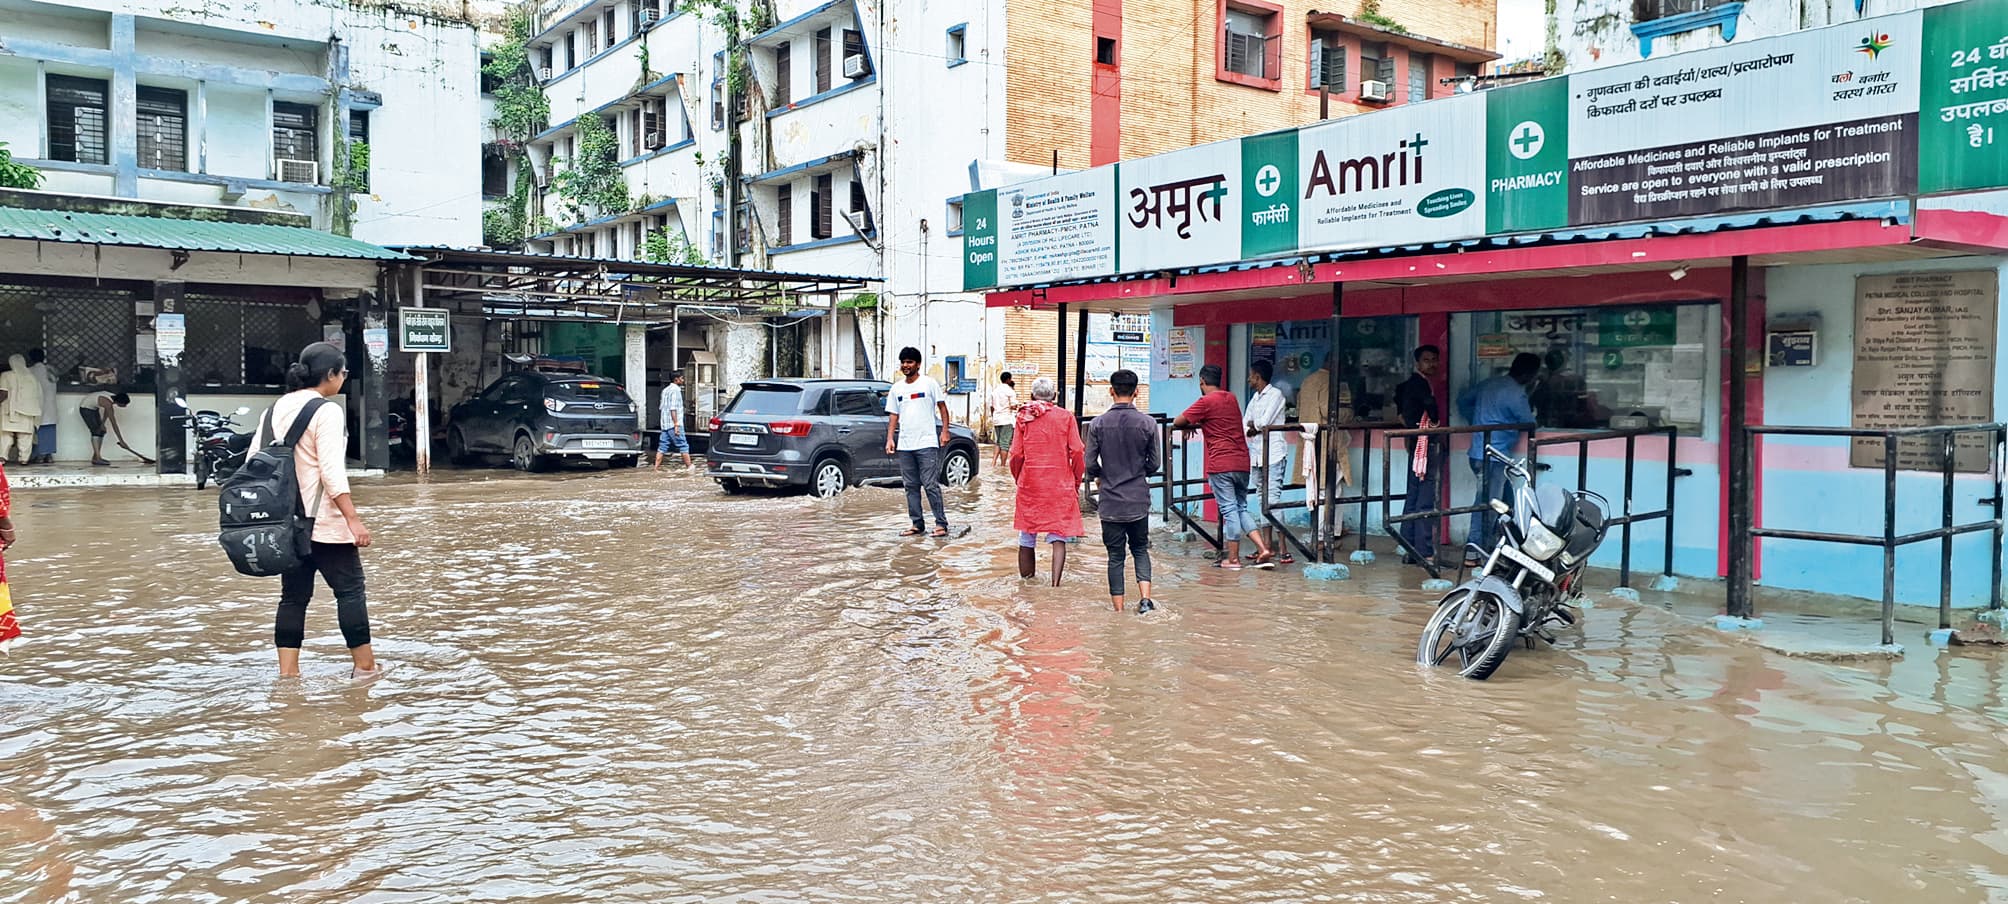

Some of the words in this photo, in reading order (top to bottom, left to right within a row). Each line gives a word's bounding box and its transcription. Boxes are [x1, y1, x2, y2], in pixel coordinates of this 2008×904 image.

[1951, 47, 1982, 68] 24
[1832, 70, 1853, 83] चलो
[1587, 82, 1631, 103] गुणवत्ता
[1634, 75, 1650, 90] की
[1833, 87, 1864, 101] स्वस्थ
[1866, 82, 1898, 95] भारत
[1587, 100, 1637, 119] किफायती
[1639, 94, 1660, 110] दरों
[1662, 95, 1676, 106] पर
[1679, 87, 1722, 105] उपलब्ध
[1940, 98, 2008, 122] उपलब्
[1573, 156, 1625, 172] Affordable
[1628, 149, 1681, 165] Medicines
[1684, 145, 1705, 158] and
[1708, 137, 1755, 154] Reliable
[1759, 131, 1810, 148] Implants
[1814, 129, 1831, 141] for
[1834, 119, 1902, 138] Treatment
[1304, 133, 1429, 200] Amrit
[1706, 157, 1722, 168] और
[1491, 171, 1563, 192] PHARMACY
[1581, 183, 1618, 196] Service
[1621, 181, 1638, 191] are
[1642, 178, 1668, 192] open
[1671, 175, 1682, 186] to
[1688, 169, 1741, 186] everyone
[1743, 165, 1768, 177] with
[1771, 165, 1778, 174] a
[1783, 160, 1811, 173] valid
[1814, 151, 1890, 172] prescription
[1426, 194, 1449, 205] Touching
[1450, 192, 1464, 200] Lives
[1708, 186, 1719, 196] पर
[1128, 174, 1228, 240] अमृत
[1252, 203, 1290, 226] फार्मेसी
[1326, 203, 1357, 215] Affordable
[1358, 201, 1389, 211] Medicines
[1390, 199, 1402, 207] and
[1424, 203, 1449, 214] Spreading
[1450, 199, 1467, 208] Smiles
[976, 217, 987, 231] 24
[1317, 215, 1340, 225] Reliable
[1341, 213, 1367, 222] Implants
[1379, 208, 1411, 217] Treatment
[1079, 221, 1099, 230] PATNA
[968, 235, 995, 248] Hours
[969, 252, 993, 266] Open
[1895, 306, 1922, 314] SANJAY
[1275, 321, 1328, 340] Amri
[250, 511, 269, 519] FILA
